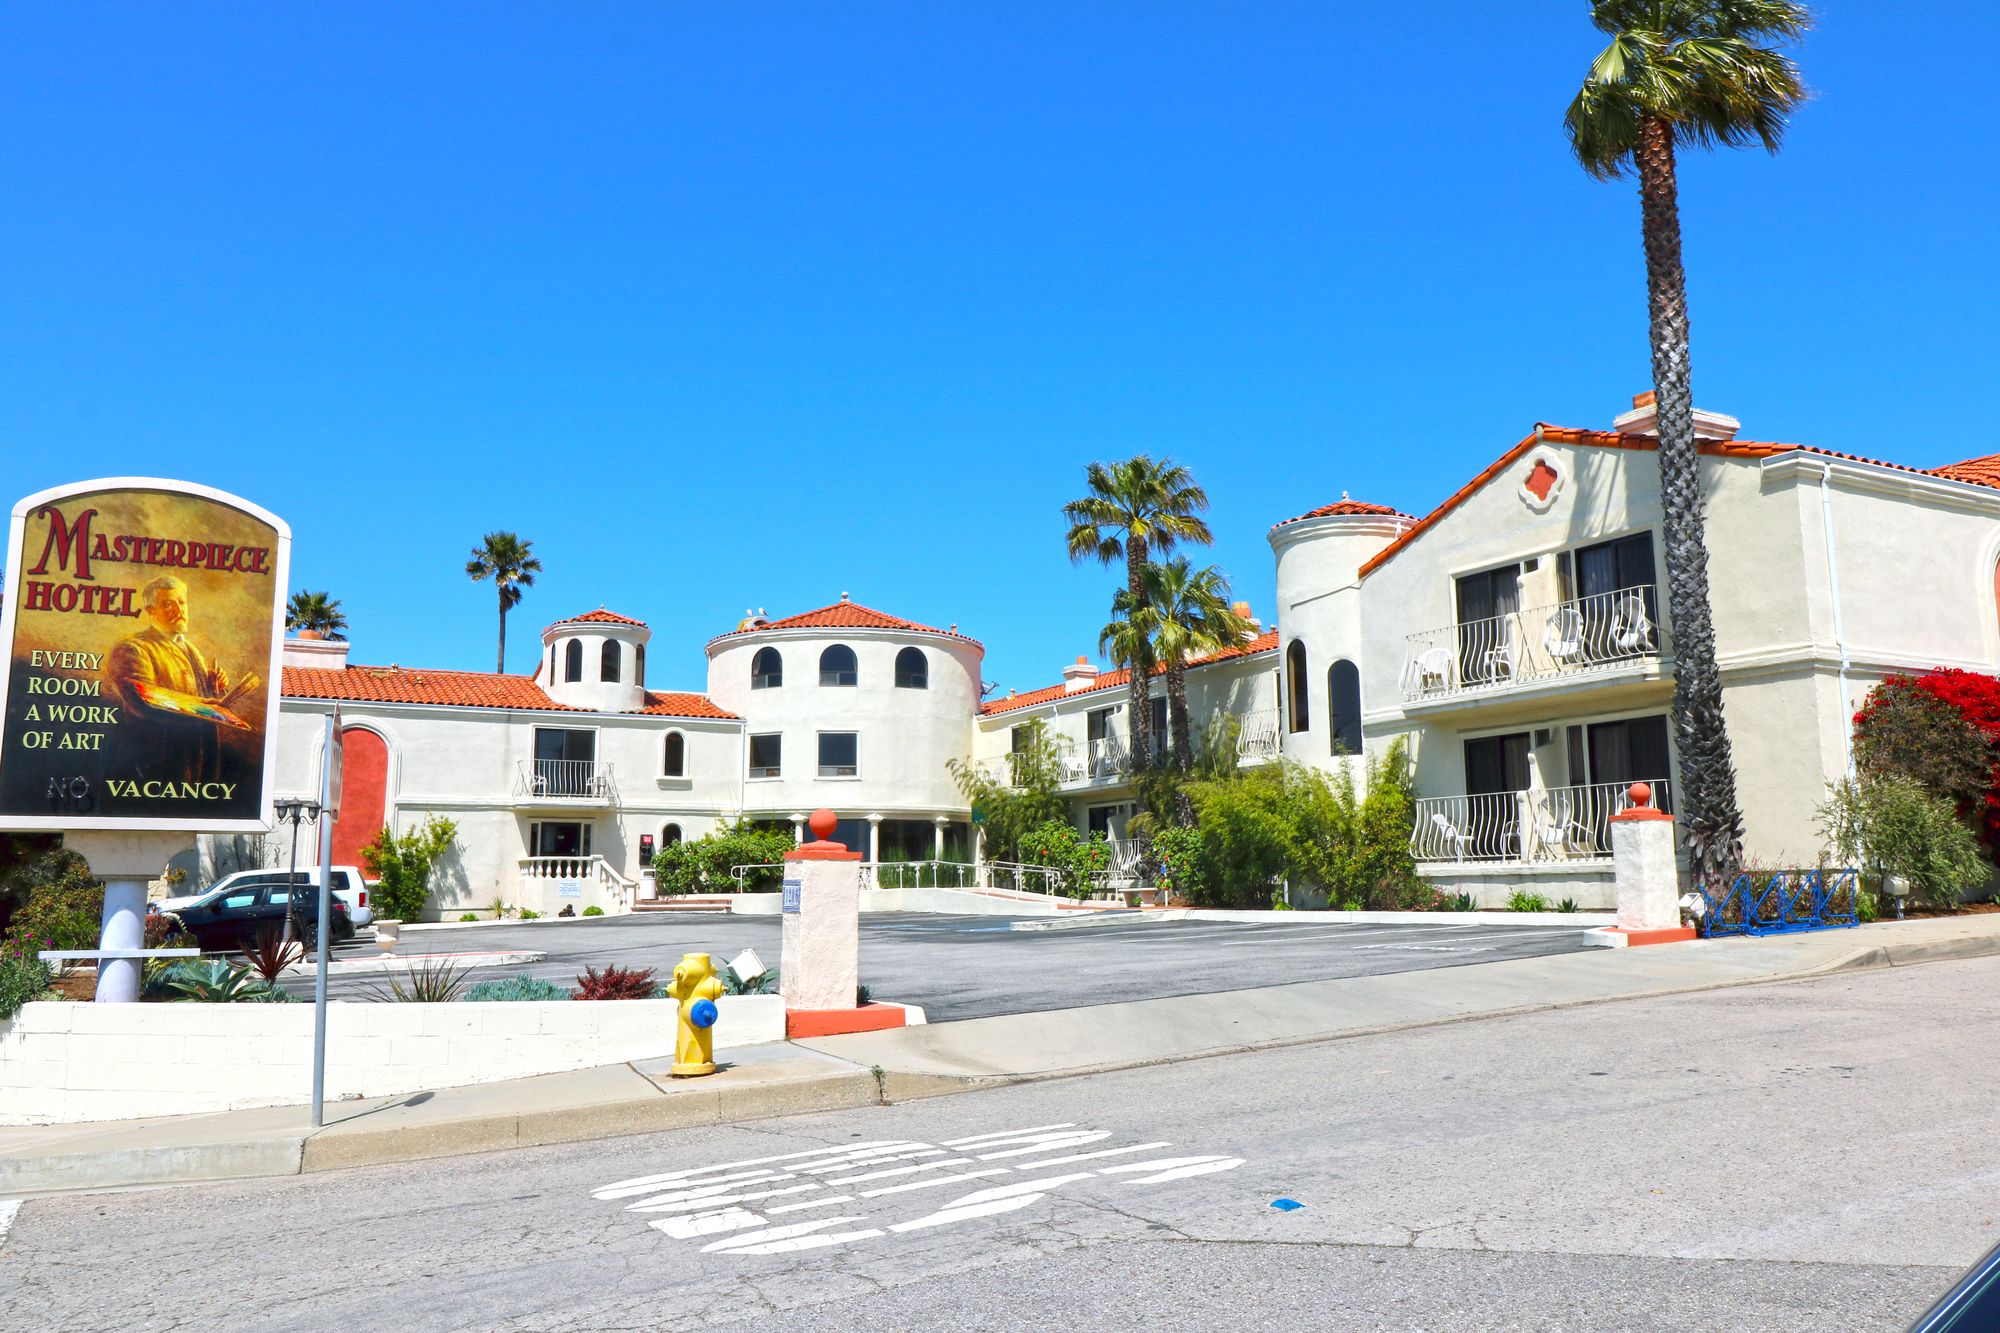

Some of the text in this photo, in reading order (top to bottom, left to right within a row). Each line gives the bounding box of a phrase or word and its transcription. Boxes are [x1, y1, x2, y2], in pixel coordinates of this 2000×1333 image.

[27, 507, 270, 580] MASTERPIECE
[24, 581, 142, 618] HOTEL
[30, 650, 103, 670] EVERY
[27, 677, 101, 696] ROOM
[24, 705, 119, 724] A WORK
[22, 731, 104, 750] OF ART
[48, 776, 236, 800] NO VACANCY
[590, 1122, 1247, 1256] STOP
